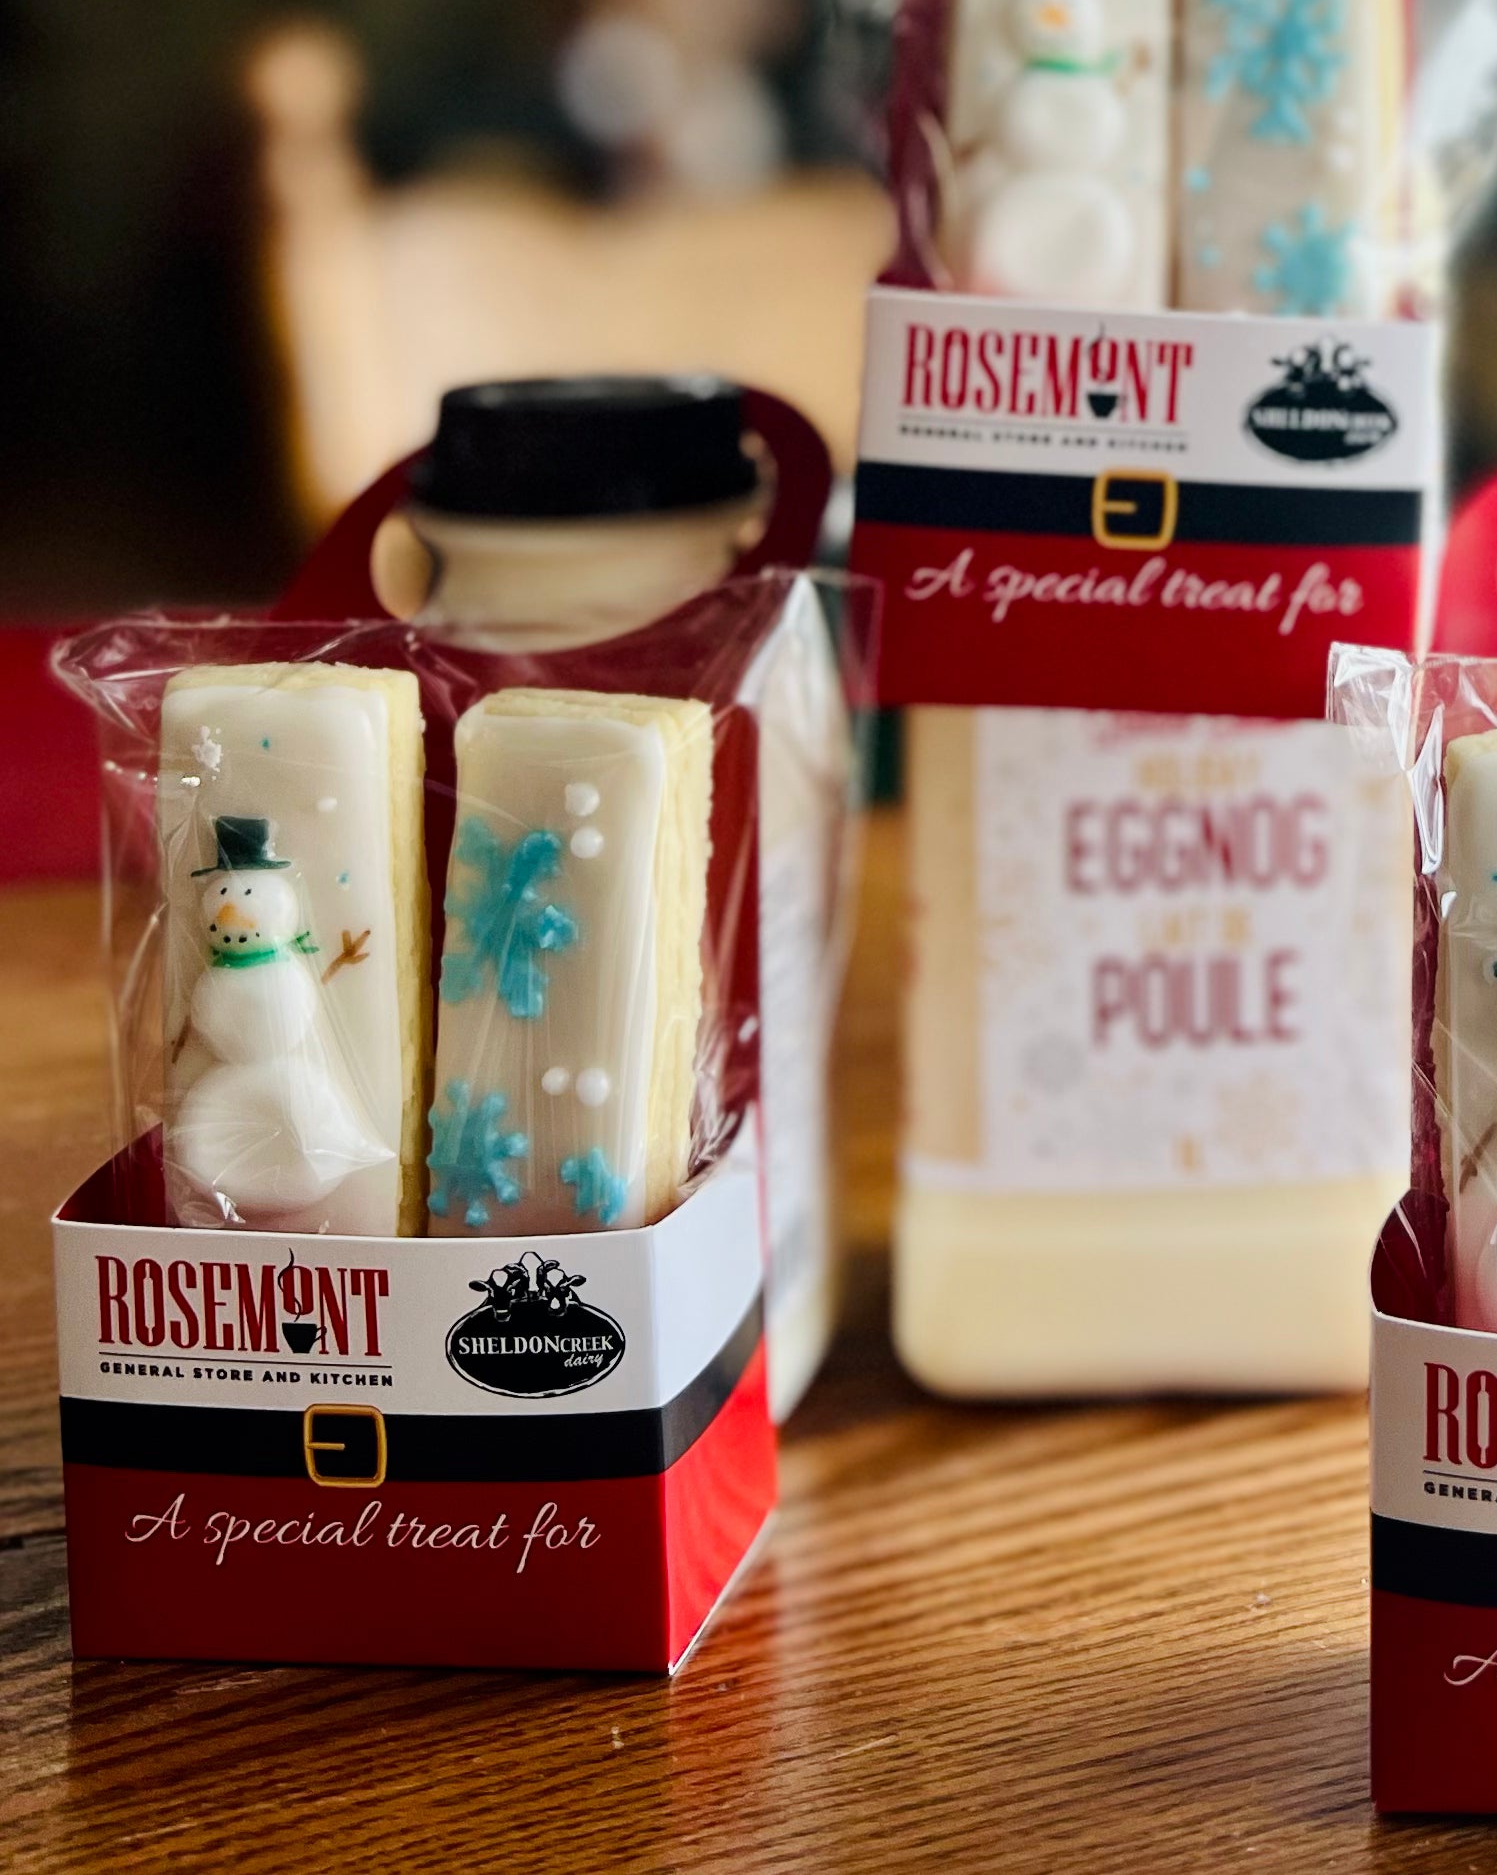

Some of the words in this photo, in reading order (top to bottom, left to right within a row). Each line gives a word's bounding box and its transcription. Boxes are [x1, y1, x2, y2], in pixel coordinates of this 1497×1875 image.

[902, 322, 1195, 423] ROSEMONT
[905, 549, 975, 600] A
[984, 557, 1166, 623] special
[1162, 569, 1281, 612] treat
[1278, 562, 1364, 636] for
[1063, 791, 1331, 895] EGGNOG
[1092, 947, 1302, 1050] POULE
[96, 1254, 390, 1357] ROSEMONT
[99, 1361, 185, 1379] GENERAL
[193, 1366, 253, 1382] STORE
[262, 1370, 301, 1384] AND
[310, 1372, 393, 1387] KITCHEN
[563, 1353, 605, 1369] dairy
[125, 1493, 191, 1544] A
[203, 1500, 383, 1566] special
[386, 1512, 510, 1550] treat
[516, 1501, 602, 1574] for
